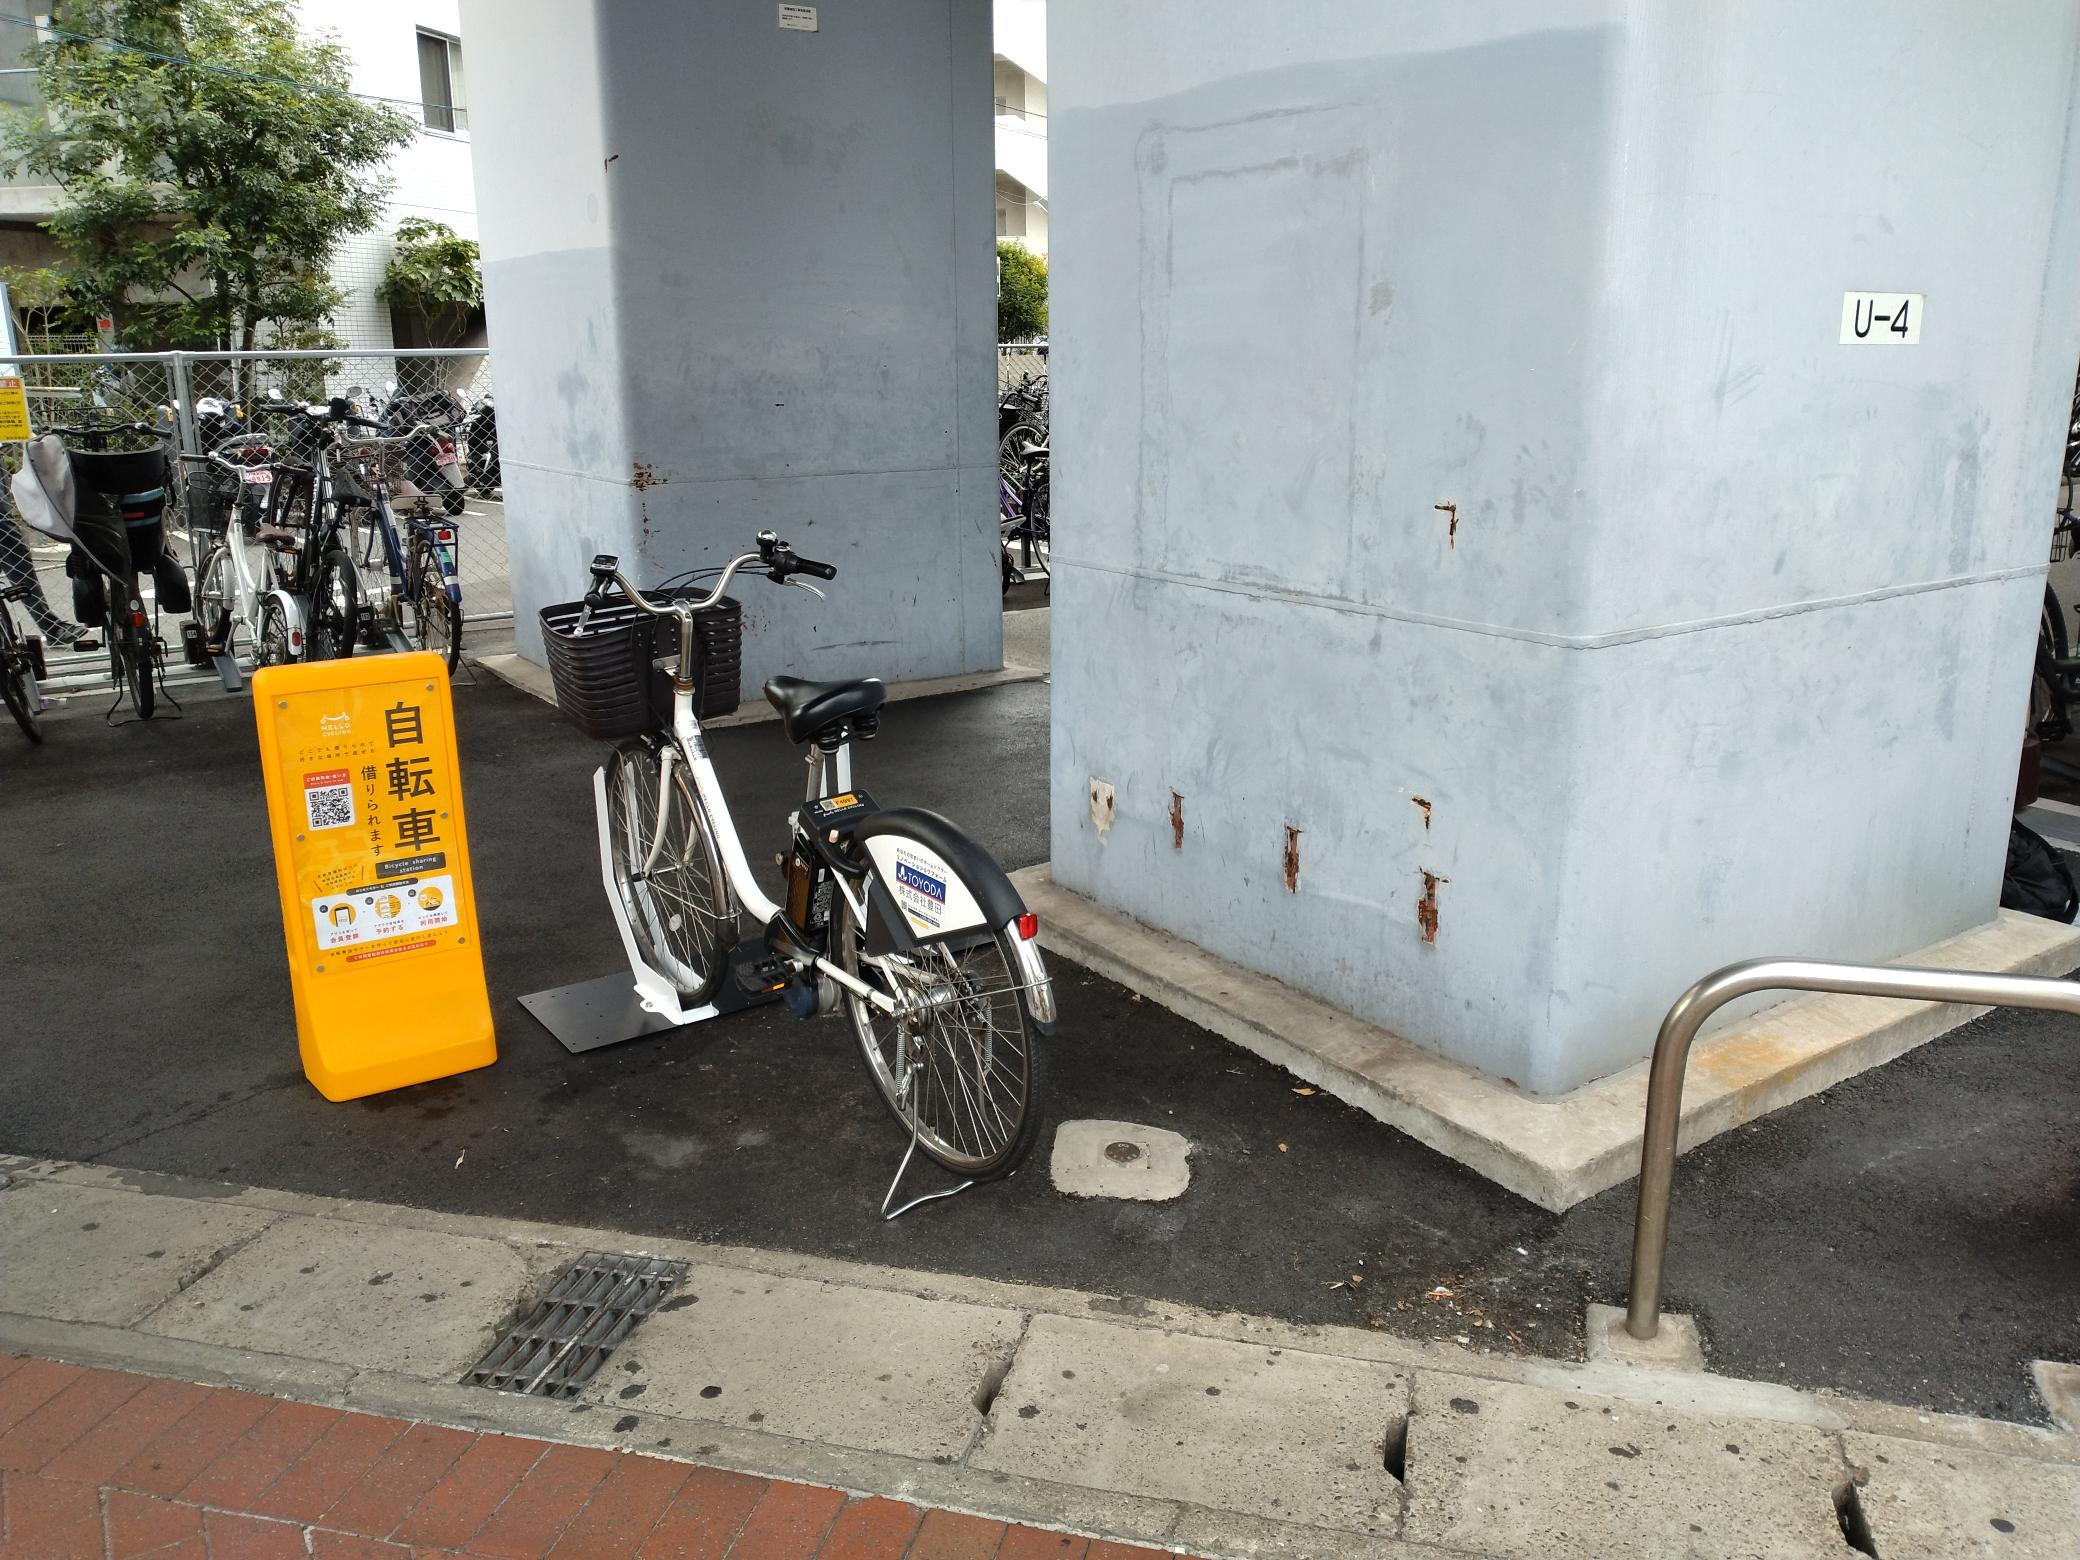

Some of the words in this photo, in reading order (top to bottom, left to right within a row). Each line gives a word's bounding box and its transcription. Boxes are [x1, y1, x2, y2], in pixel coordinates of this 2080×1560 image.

[1854, 298, 1910, 339] U-4
[321, 723, 351, 731] HELLO
[385, 701, 441, 851] 自転車
[361, 764, 384, 857] 借りられます
[384, 860, 409, 871] Bicycle
[412, 856, 437, 866] sharing
[399, 864, 424, 874] station
[907, 872, 943, 900] TOYODA
[899, 885, 942, 915] 株式会社豊田
[419, 916, 449, 927] 利用開始
[375, 924, 405, 935] 予約する
[330, 933, 360, 944] 会員登録
